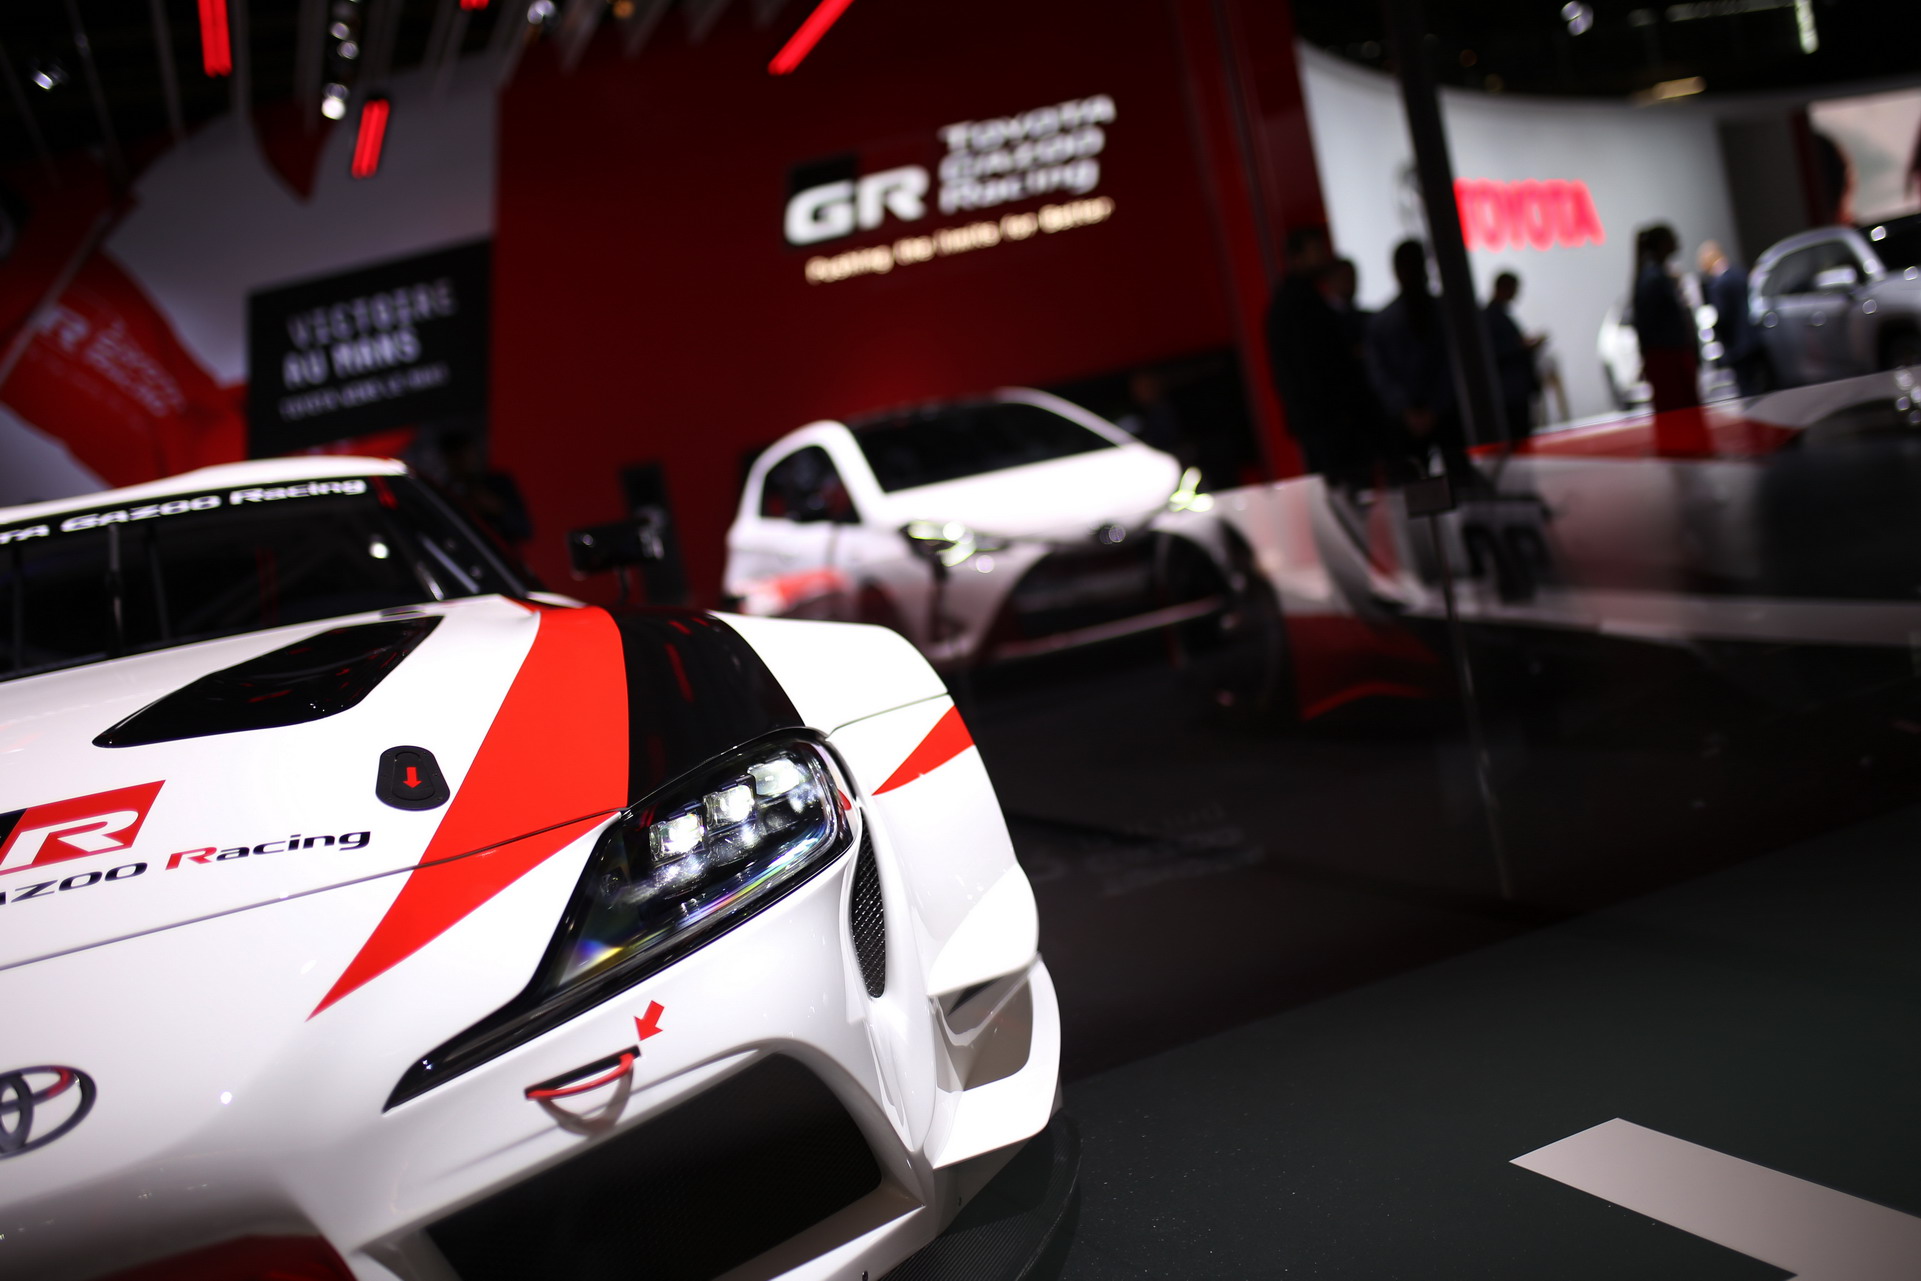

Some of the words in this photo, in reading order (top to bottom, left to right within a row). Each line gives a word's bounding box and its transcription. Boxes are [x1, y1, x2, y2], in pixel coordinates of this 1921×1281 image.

[784, 165, 930, 245] GR
[229, 479, 367, 505] Racing
[165, 831, 371, 870] Racing
